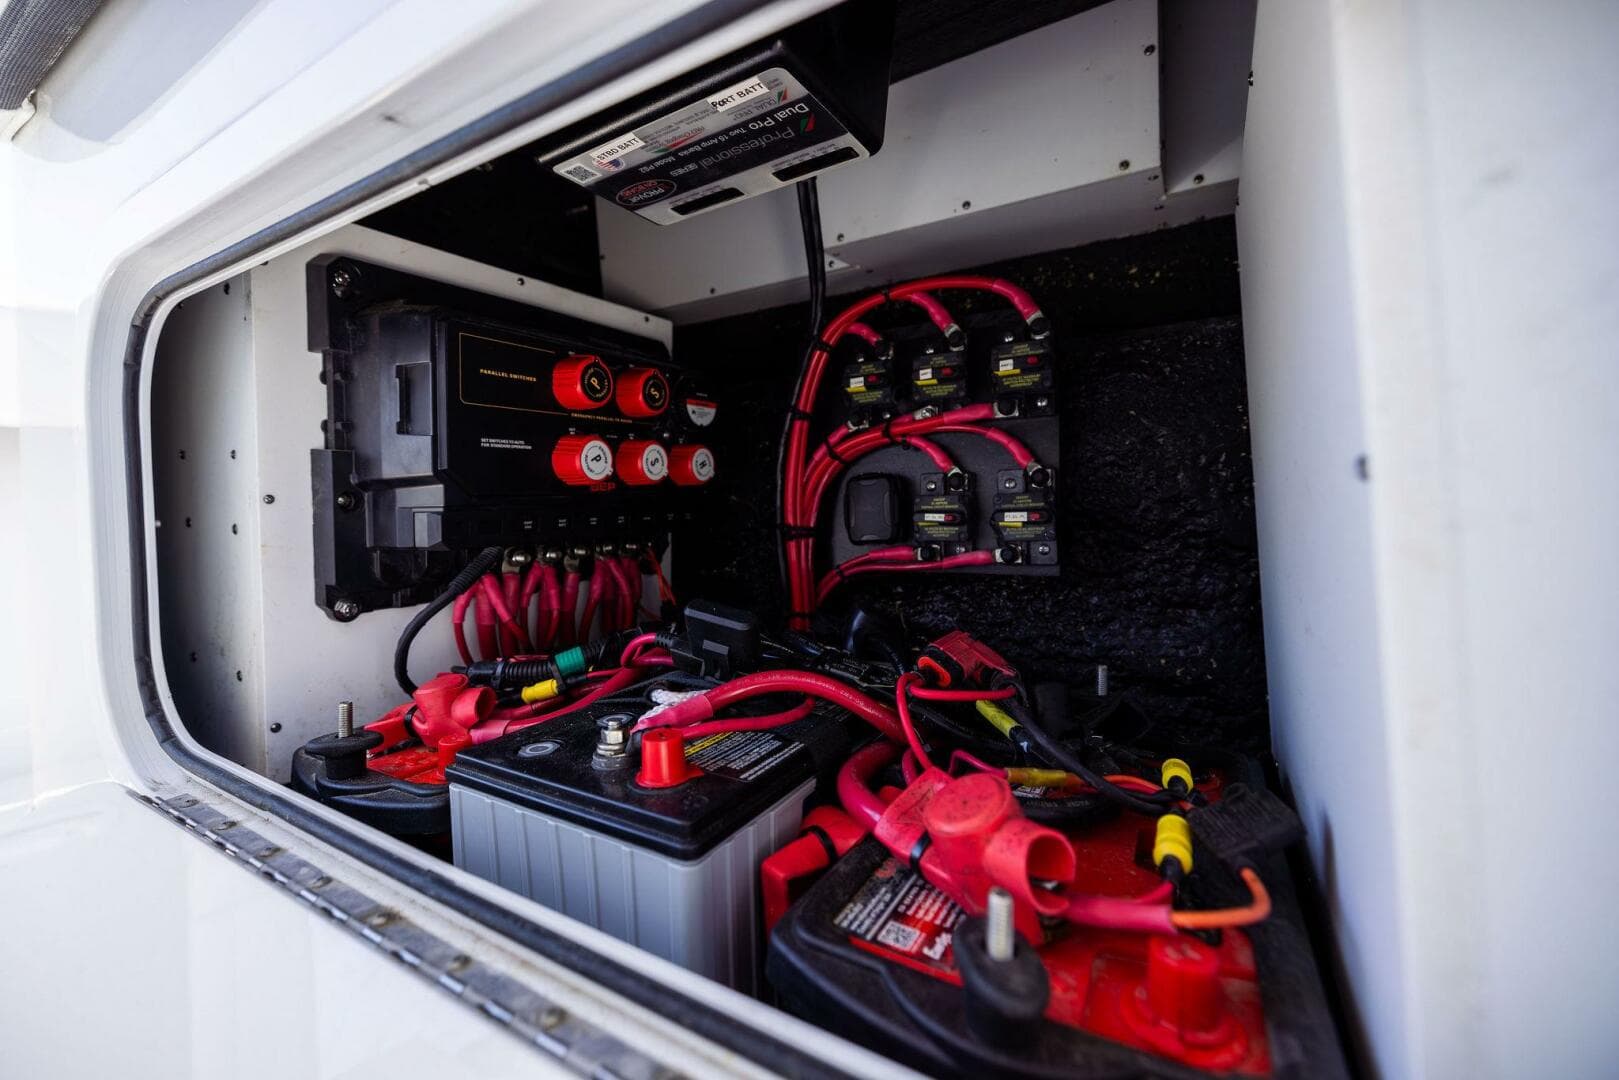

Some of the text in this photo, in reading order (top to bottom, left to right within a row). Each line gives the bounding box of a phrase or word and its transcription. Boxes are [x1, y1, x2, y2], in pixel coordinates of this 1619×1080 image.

[736, 82, 764, 98] BATT
[774, 103, 809, 122] Dual
[748, 118, 775, 130] Pro
[597, 148, 619, 160] STBD
[617, 138, 639, 150] BATT
[698, 126, 795, 169] Professional
[479, 368, 537, 382] PARALLEL SWITCHES
[591, 453, 602, 462] P
